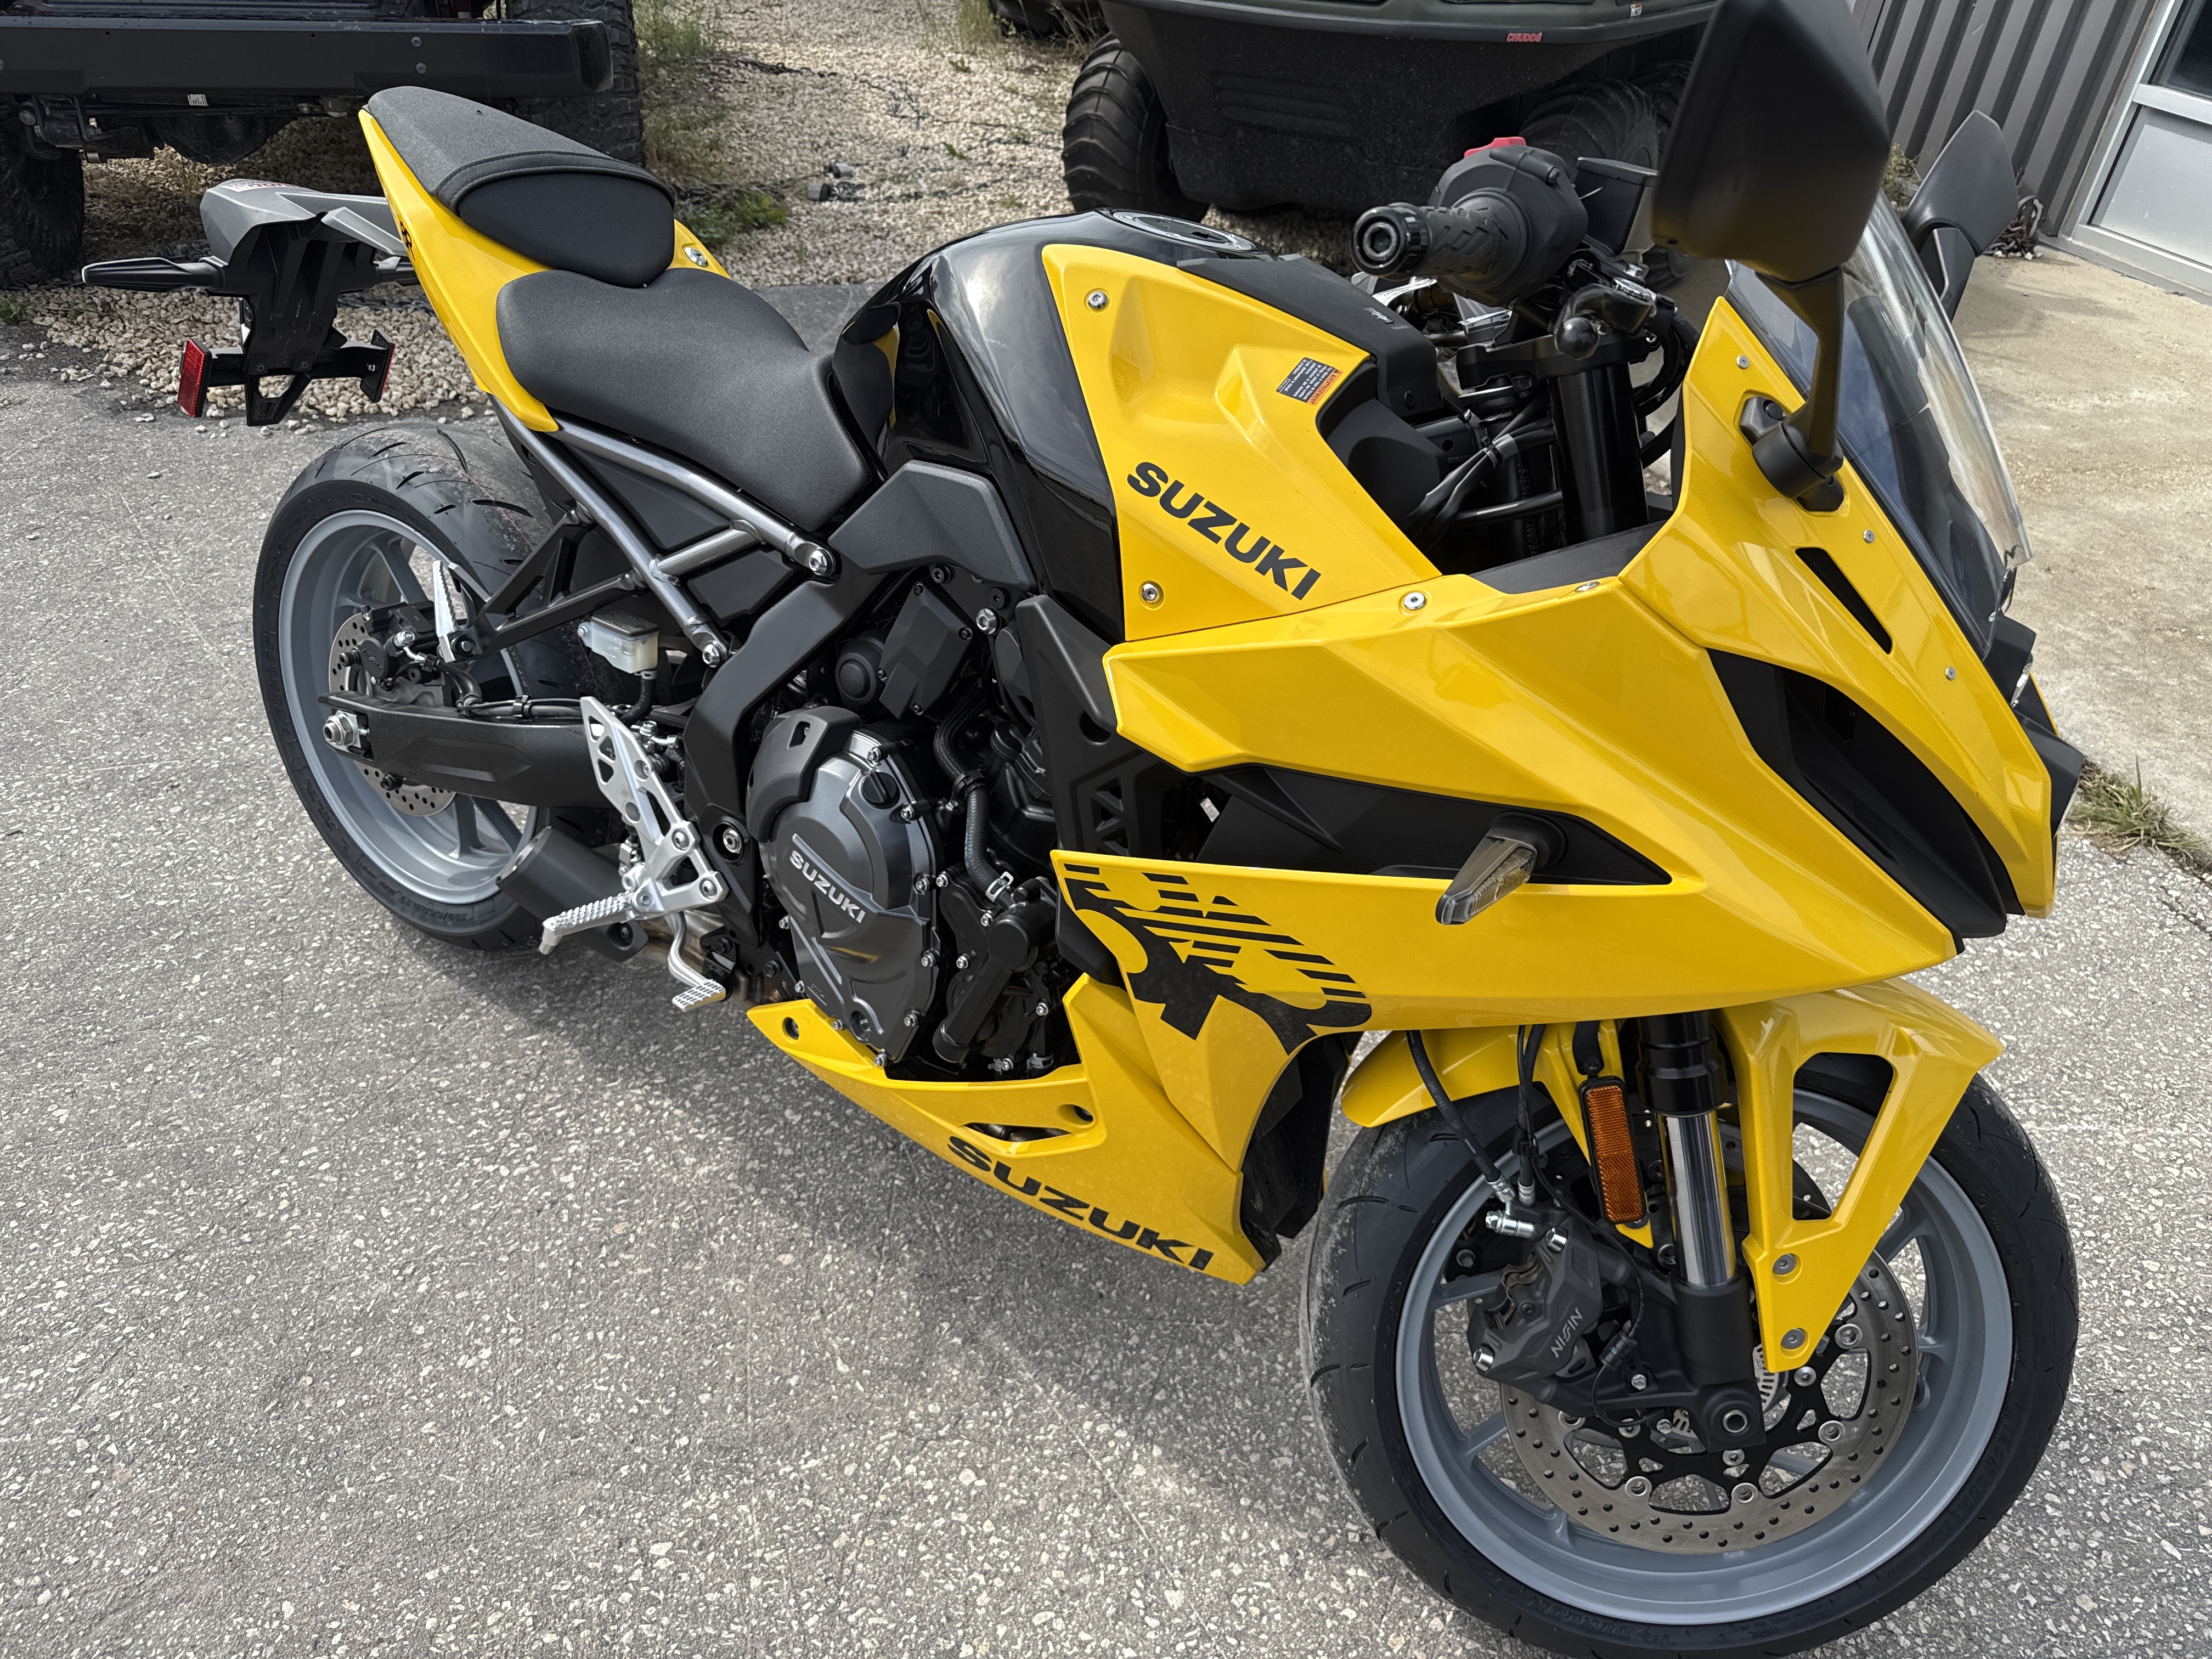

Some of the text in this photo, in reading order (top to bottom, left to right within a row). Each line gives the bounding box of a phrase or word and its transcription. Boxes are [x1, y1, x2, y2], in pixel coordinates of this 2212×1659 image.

[1309, 374, 1336, 404] AVERTISSEMENT
[1126, 461, 1322, 601] SUZUKI
[789, 849, 866, 924] SUZUKI
[1427, 1081, 1437, 1093] SAE
[947, 1136, 1215, 1271] SUZUKI
